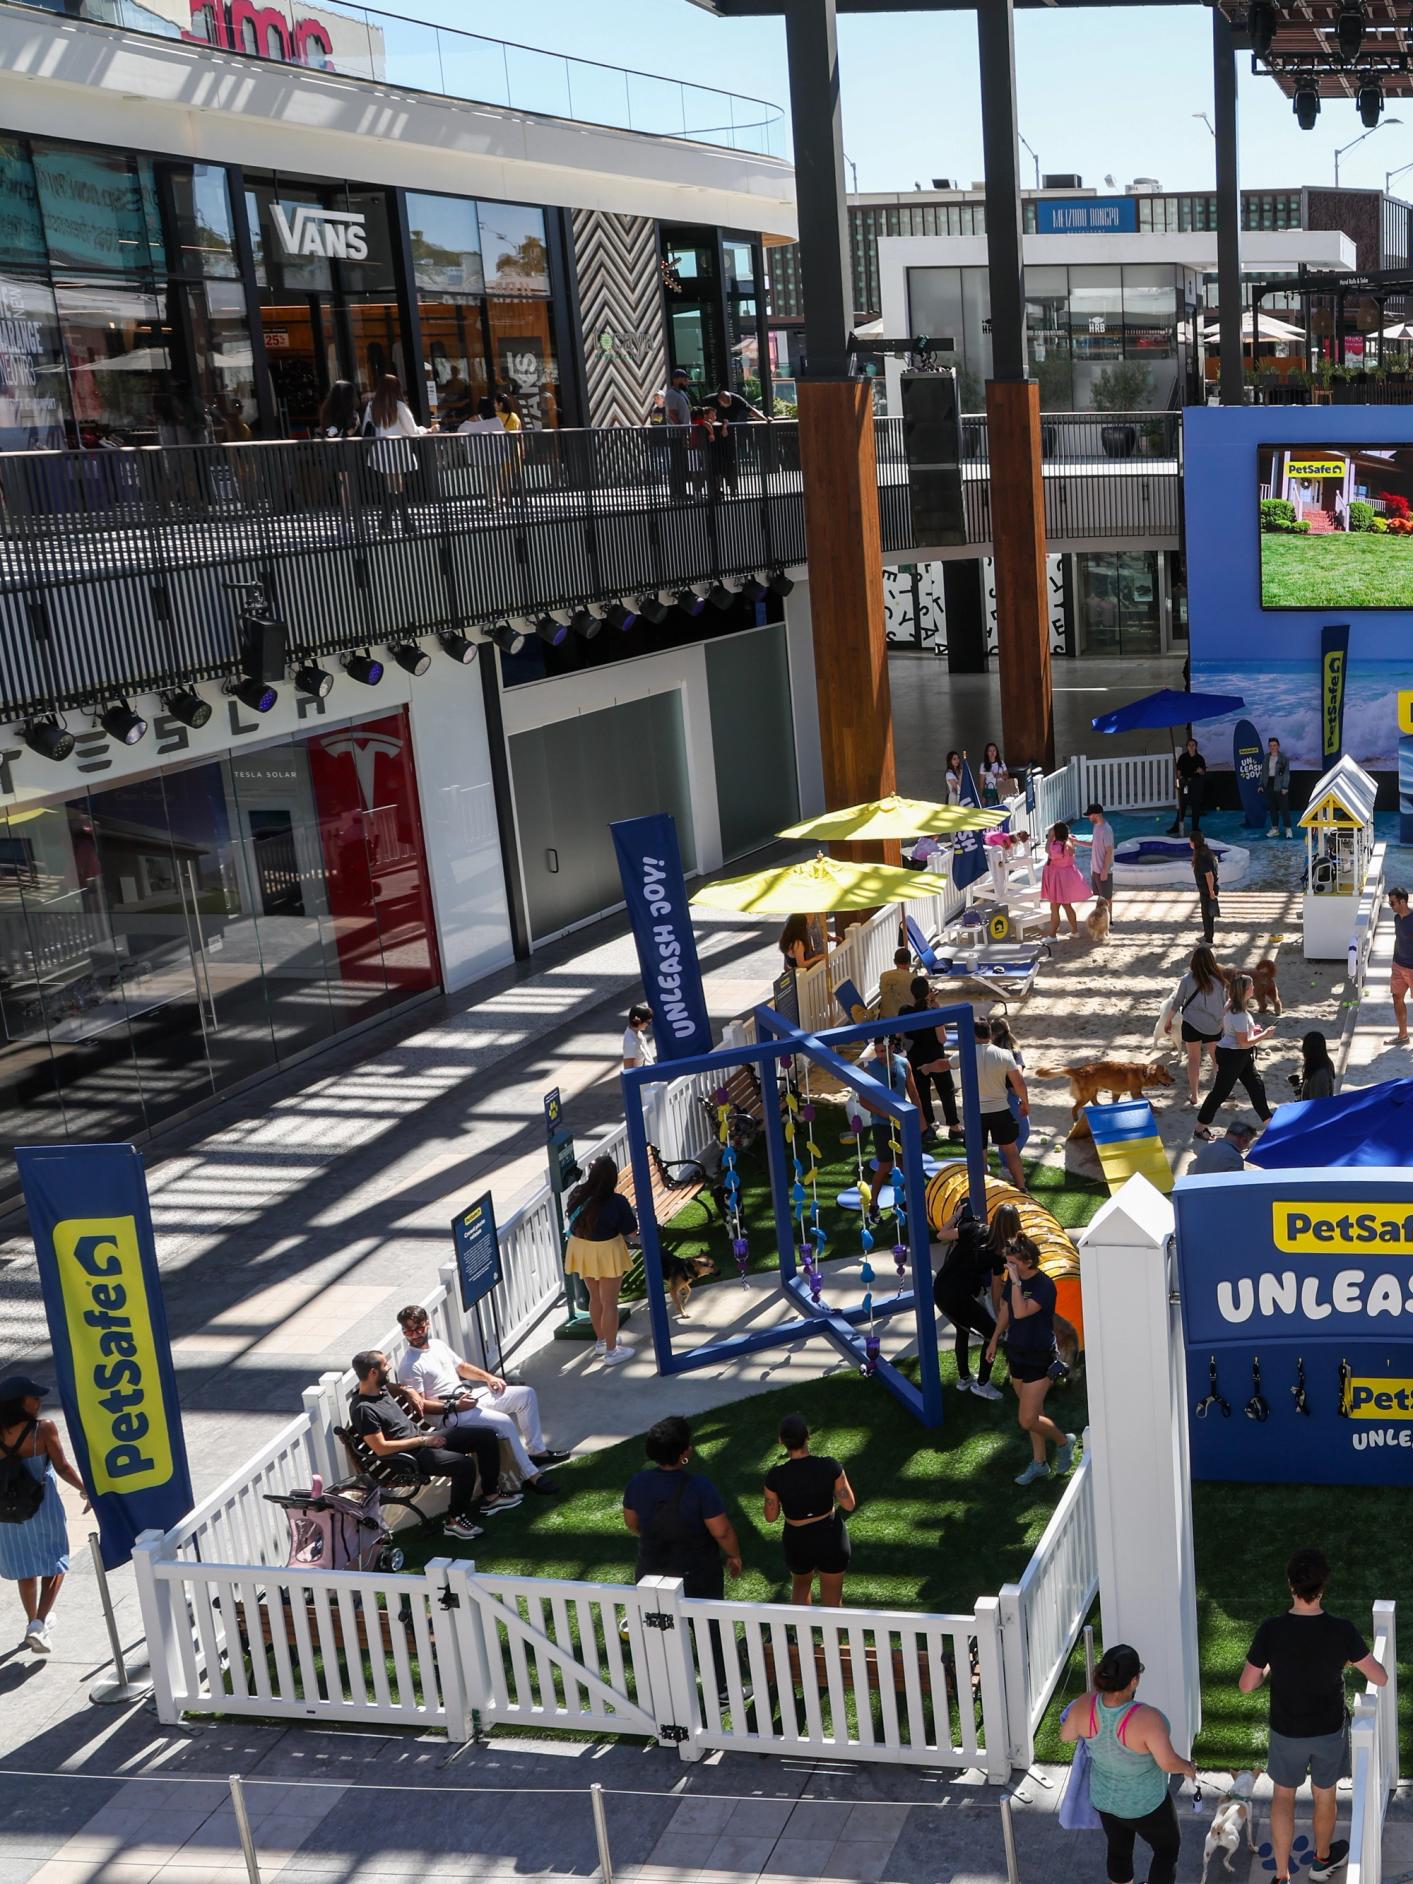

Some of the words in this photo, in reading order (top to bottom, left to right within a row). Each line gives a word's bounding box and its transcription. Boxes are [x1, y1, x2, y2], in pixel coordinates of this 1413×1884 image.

[269, 203, 368, 260] VANS
[982, 323, 992, 334] HR
[1088, 323, 1106, 333] HRB
[1288, 463, 1332, 475] PetSafe
[1327, 674, 1341, 748] PetSafe
[642, 856, 672, 918] JOY!
[653, 924, 696, 1038] UNLEASH
[84, 1283, 155, 1479] PetSafe
